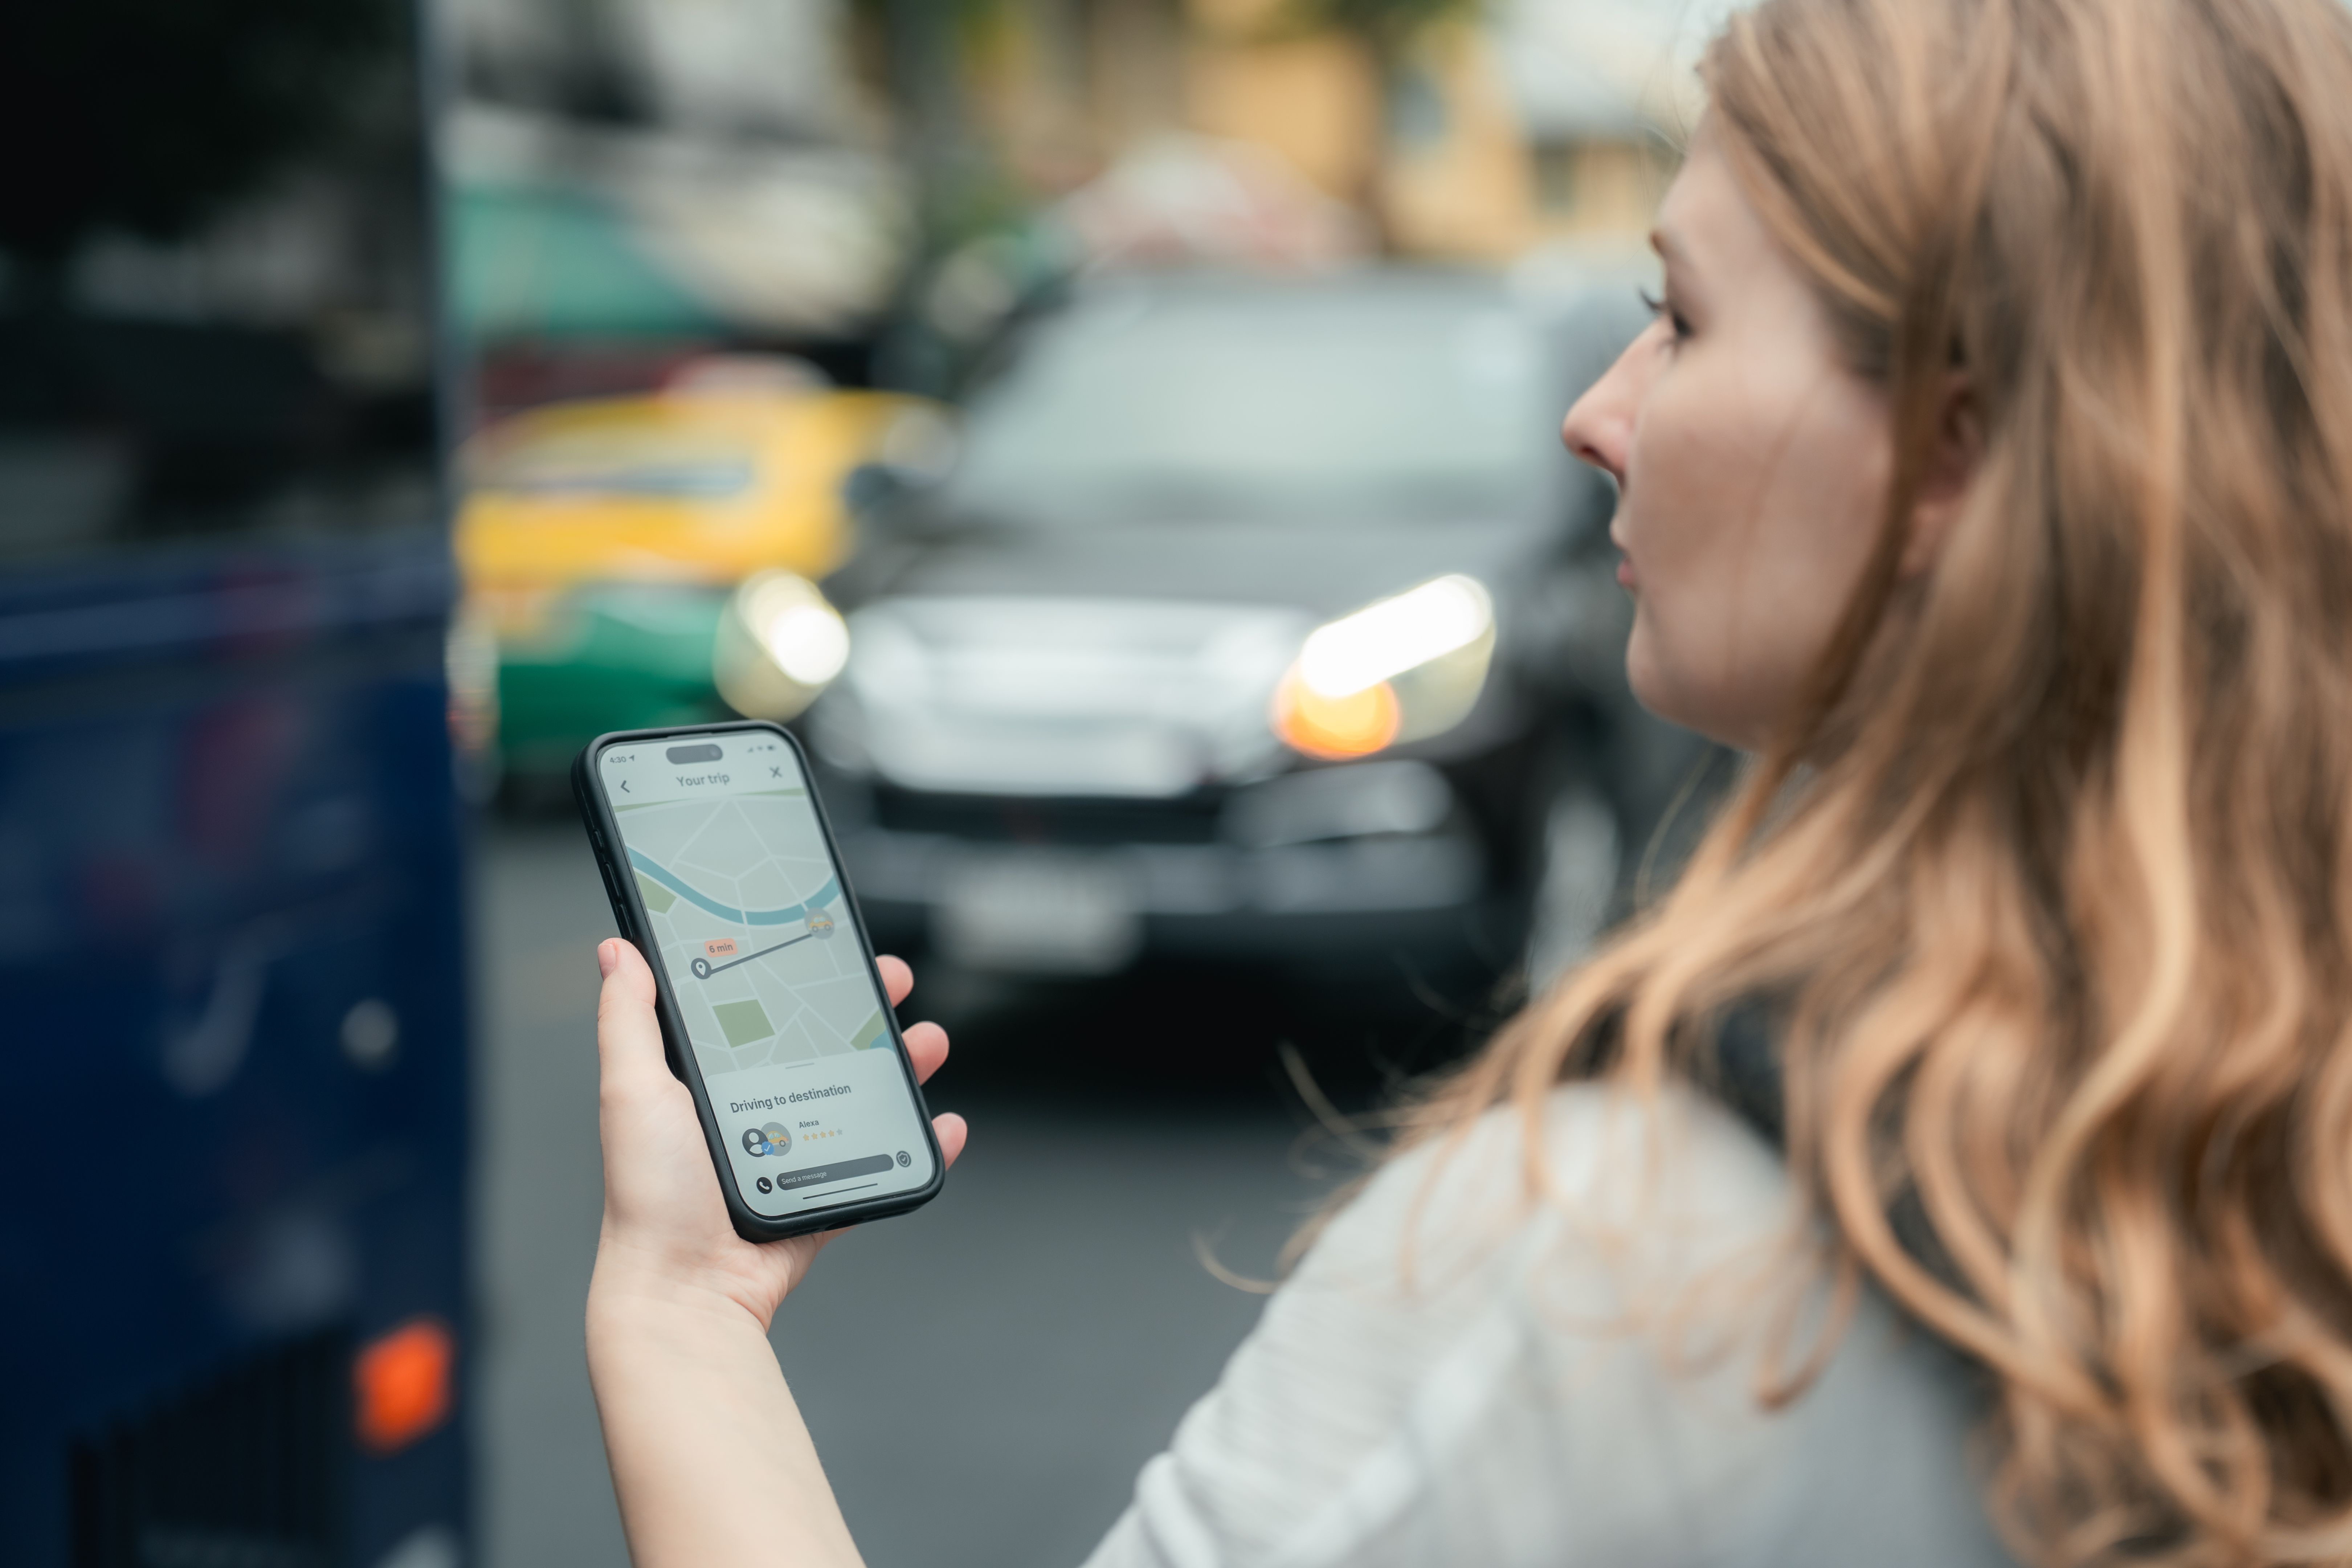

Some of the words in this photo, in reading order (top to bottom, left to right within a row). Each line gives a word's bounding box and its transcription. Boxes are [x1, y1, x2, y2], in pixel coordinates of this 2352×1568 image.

[676, 776, 705, 787] Your
[707, 772, 730, 786] trip
[716, 943, 734, 952] min
[730, 1098, 773, 1113] Driving
[774, 1096, 786, 1105] to
[789, 1085, 852, 1103] destination
[799, 1120, 819, 1128] Alexa
[802, 1172, 827, 1180] message
